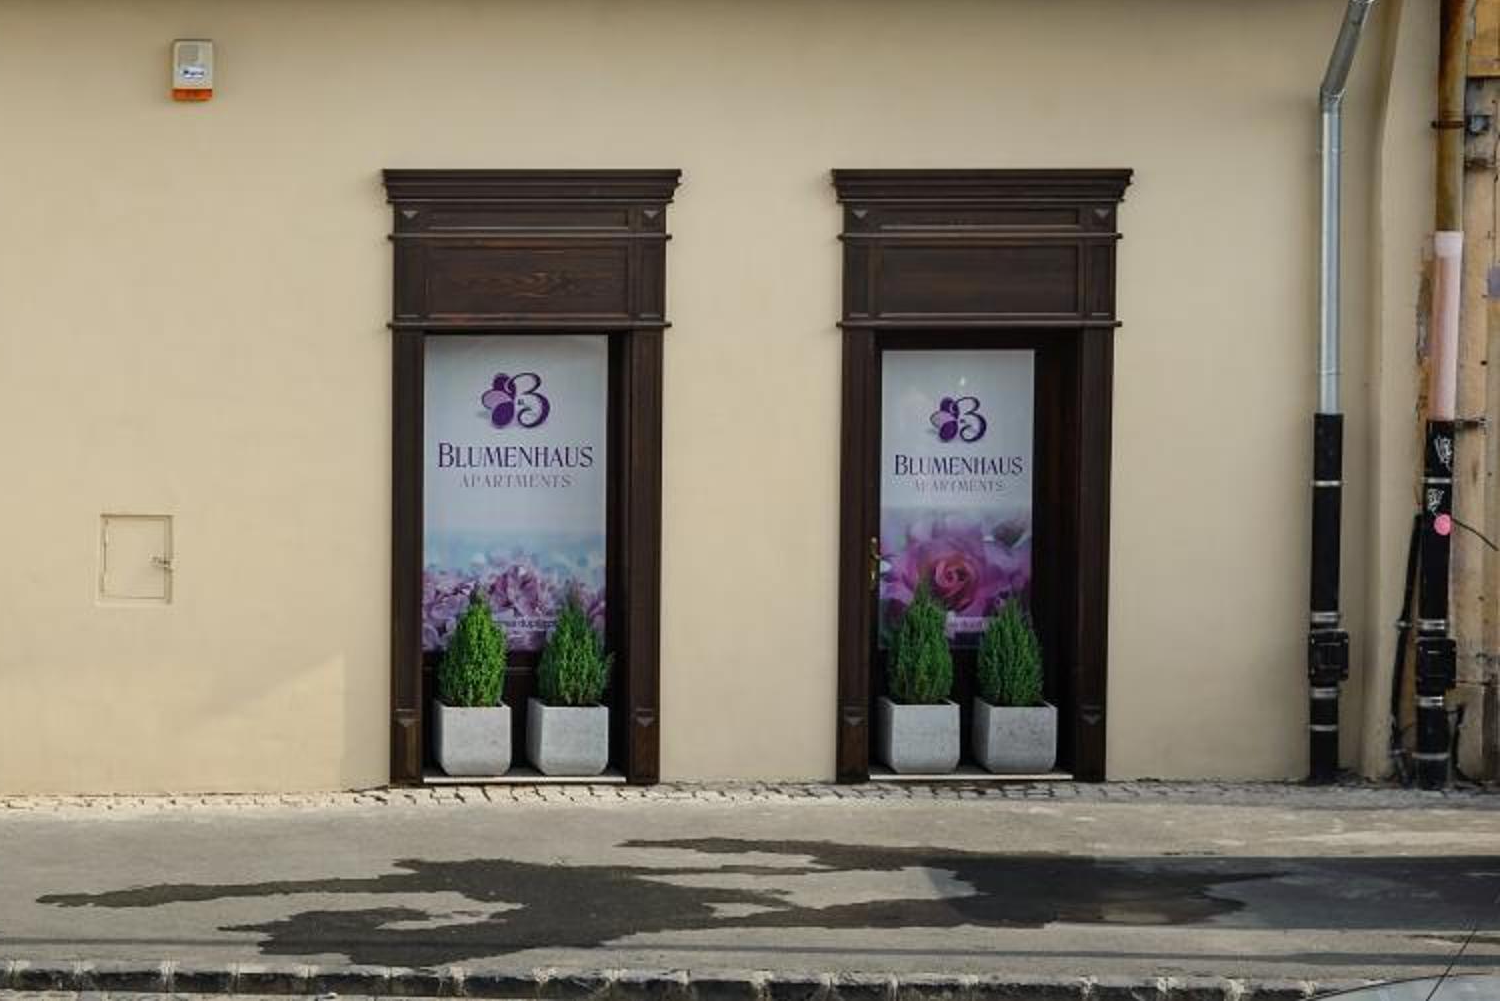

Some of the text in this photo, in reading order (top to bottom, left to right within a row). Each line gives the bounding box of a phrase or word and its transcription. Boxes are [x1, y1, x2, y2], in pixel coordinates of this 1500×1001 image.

[438, 442, 594, 468] BLUMENHAUS
[895, 454, 1024, 476] BLUMENHAUS
[459, 473, 573, 488] APARTMENTS
[914, 479, 1004, 493] APARTMENTS
